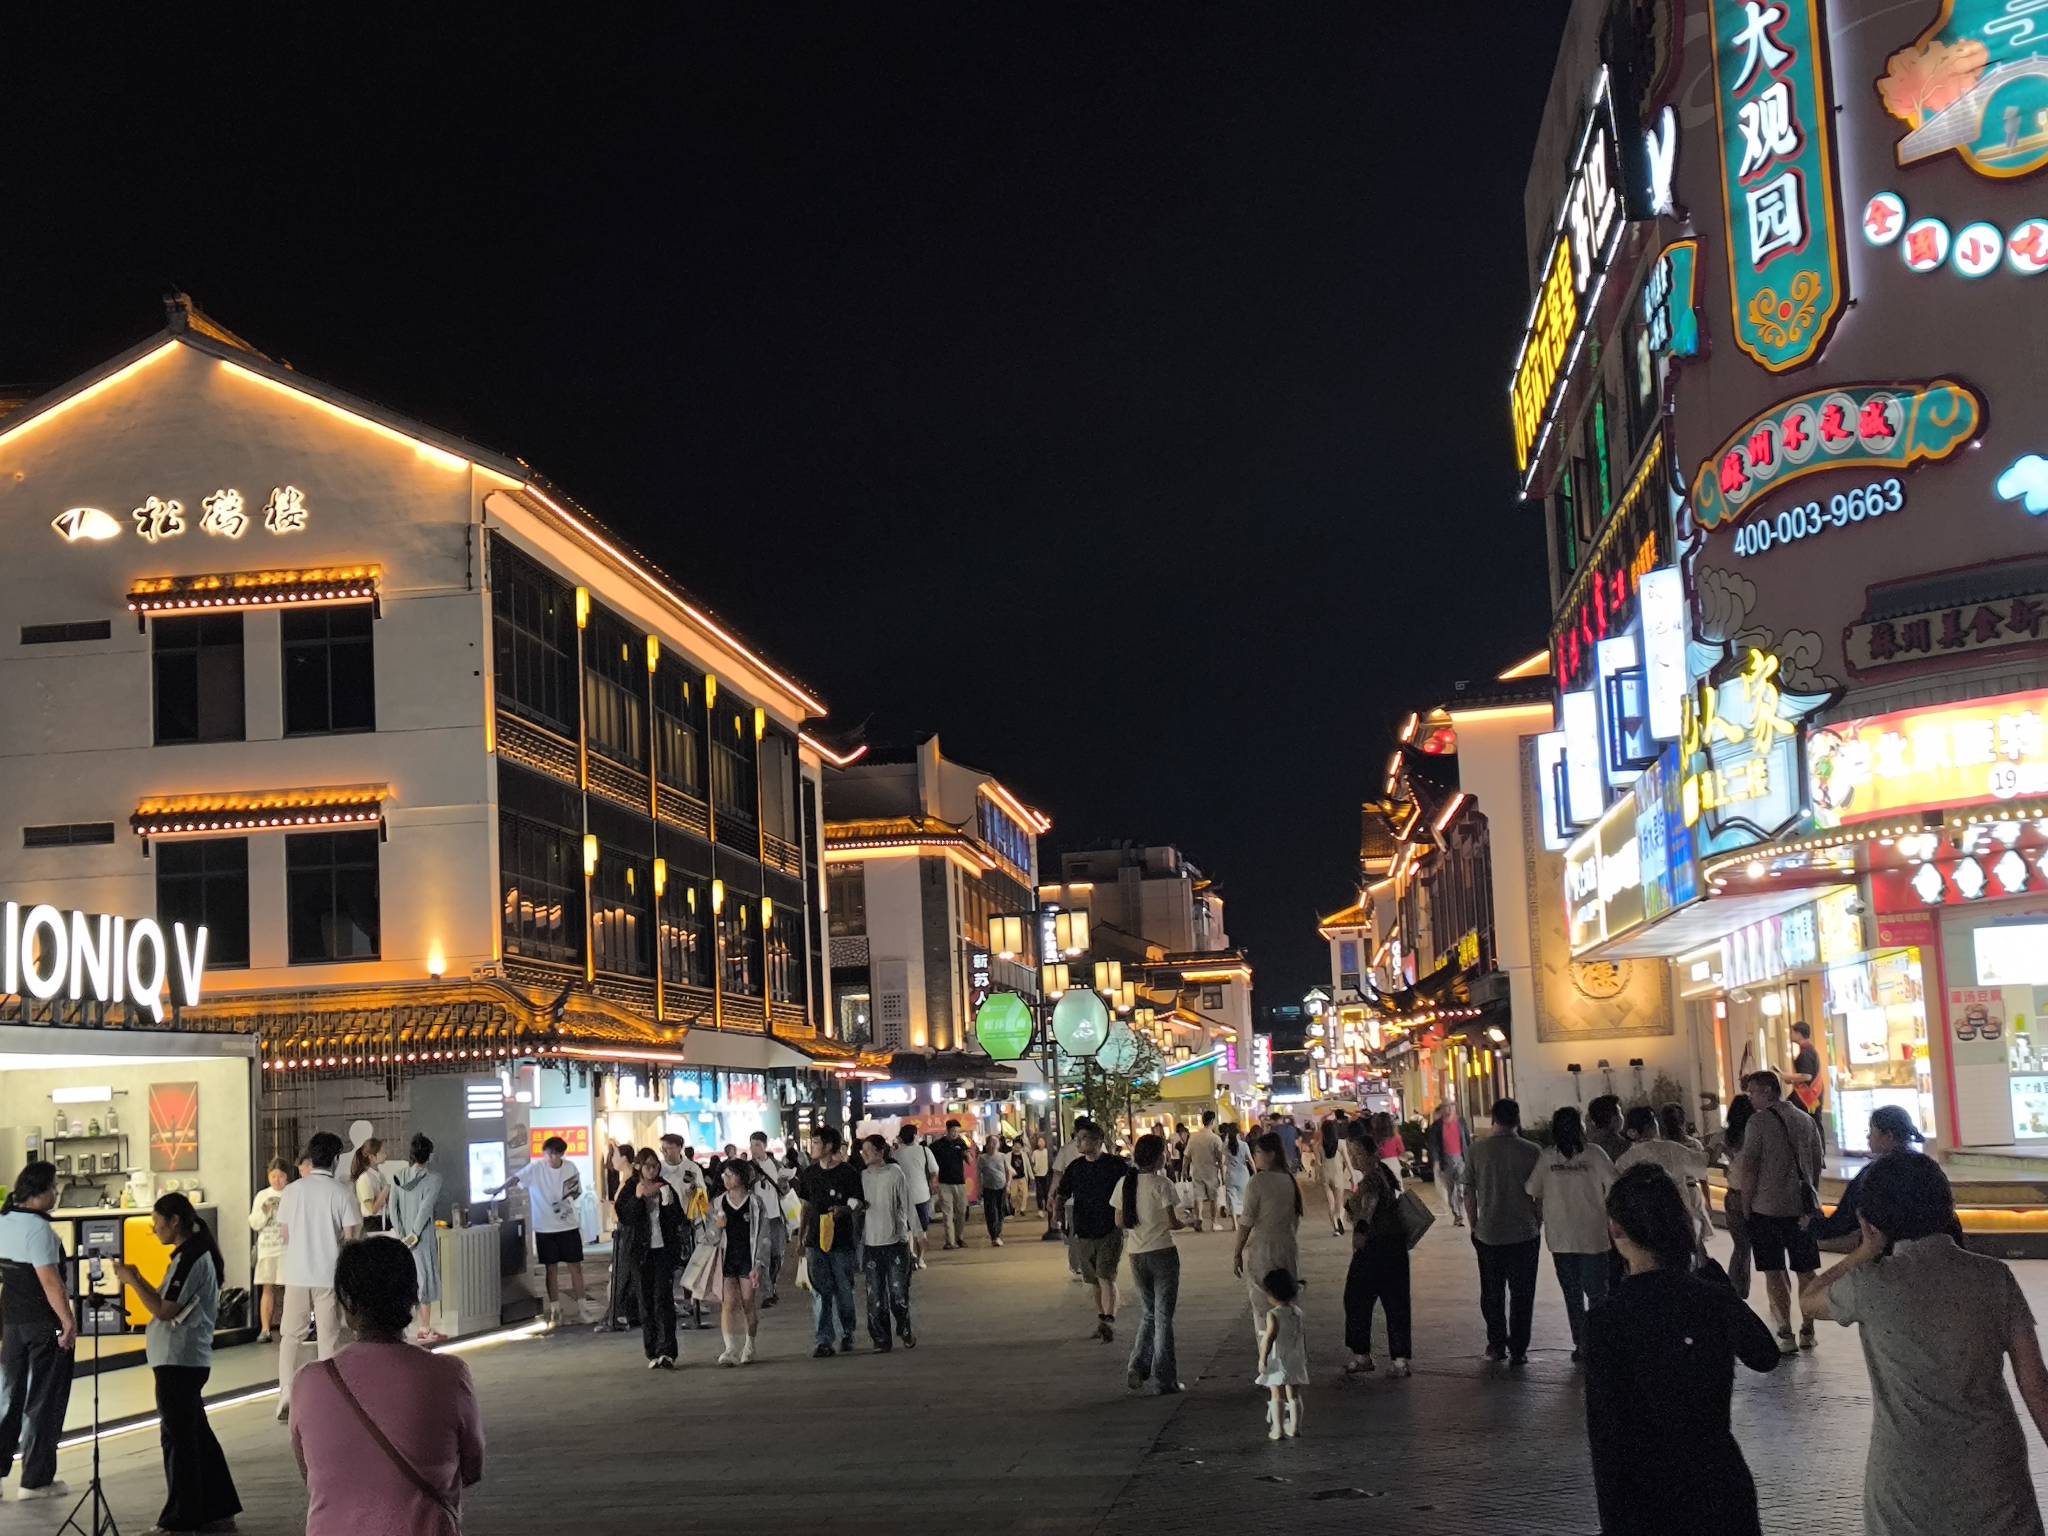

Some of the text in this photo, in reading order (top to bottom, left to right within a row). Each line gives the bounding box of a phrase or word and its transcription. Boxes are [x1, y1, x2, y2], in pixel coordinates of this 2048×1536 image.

[1732, 1, 1803, 267] 大观园
[1734, 477, 1904, 558] 400-003-9663
[4, 901, 209, 1024] IONIQ V
[972, 953, 990, 1014] 新苏人
